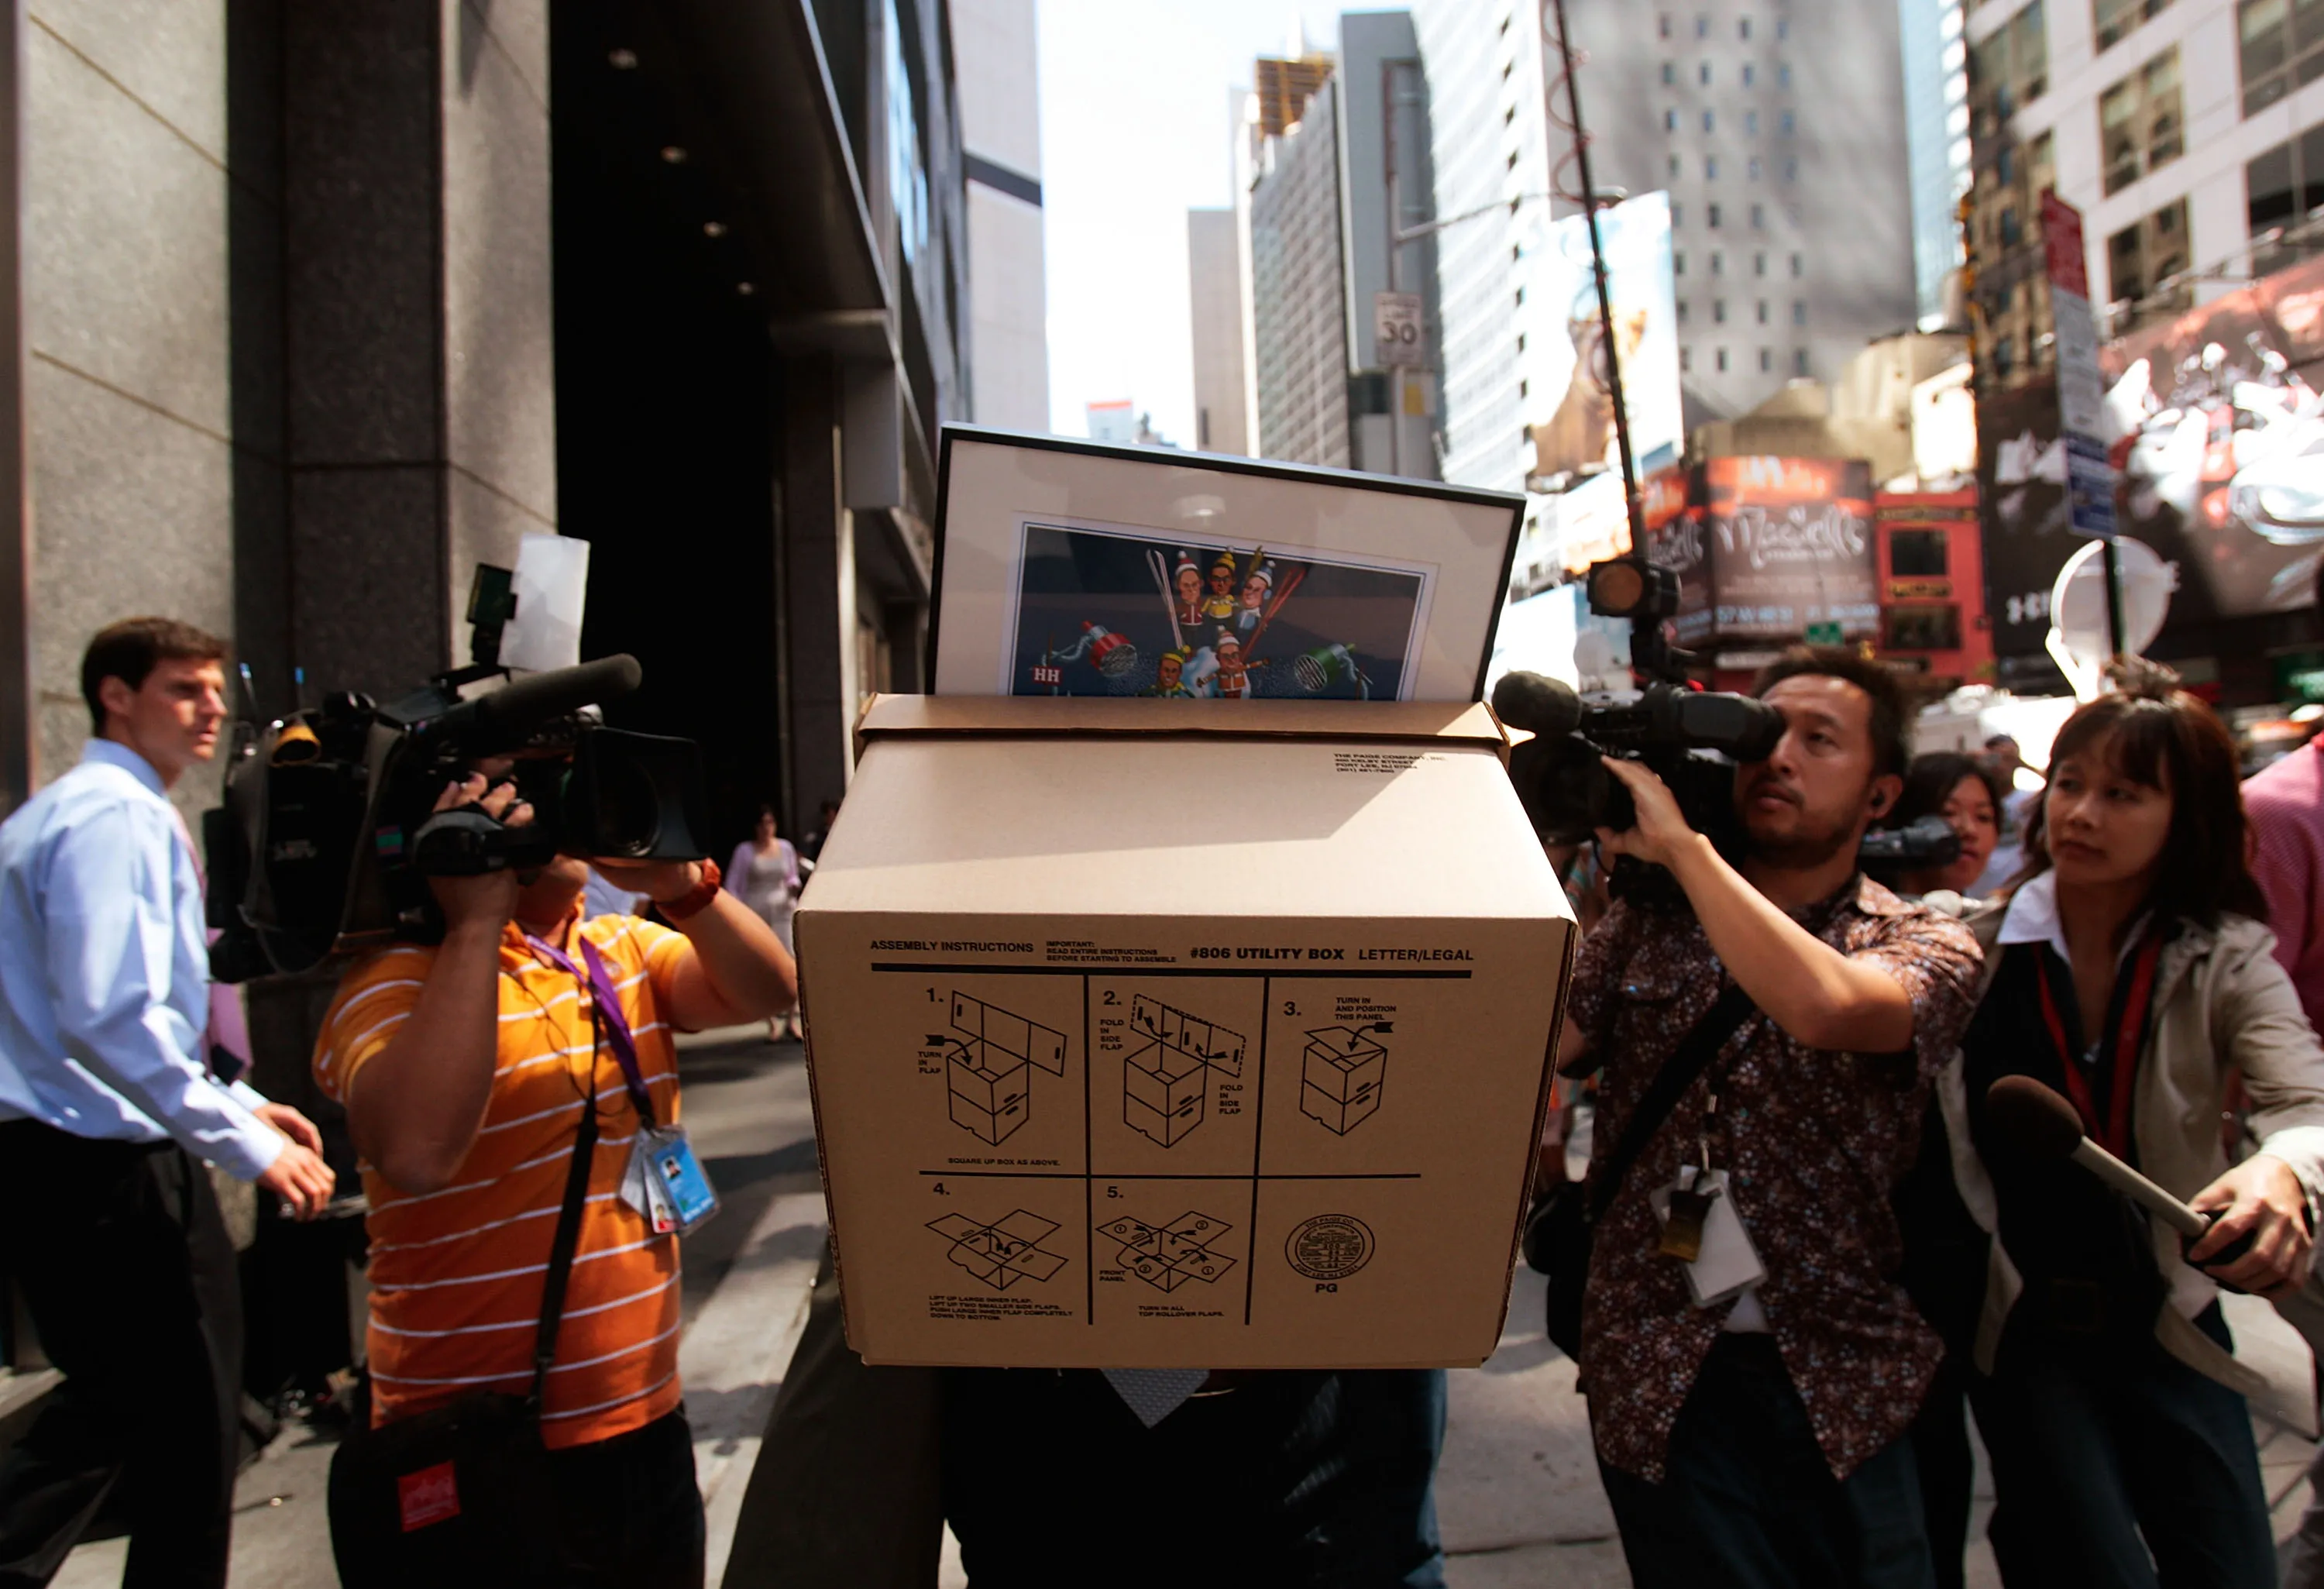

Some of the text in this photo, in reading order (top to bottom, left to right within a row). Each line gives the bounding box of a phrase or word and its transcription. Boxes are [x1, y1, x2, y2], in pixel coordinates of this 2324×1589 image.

[1382, 321, 1418, 345] 30
[1034, 668, 1061, 683] HH
[871, 941, 1033, 952] ASSEMBLY INSTRUCTIONS
[1190, 947, 1344, 960] #806 UTILITY BOX
[1359, 949, 1474, 962] LETTER/LEGAL
[927, 988, 944, 1002] 1.
[1103, 990, 1122, 1005] 2.
[1283, 1002, 1301, 1016] 3.
[933, 1182, 950, 1195] 4.
[1107, 1186, 1124, 1199] 5.
[1315, 1283, 1338, 1293] PG
